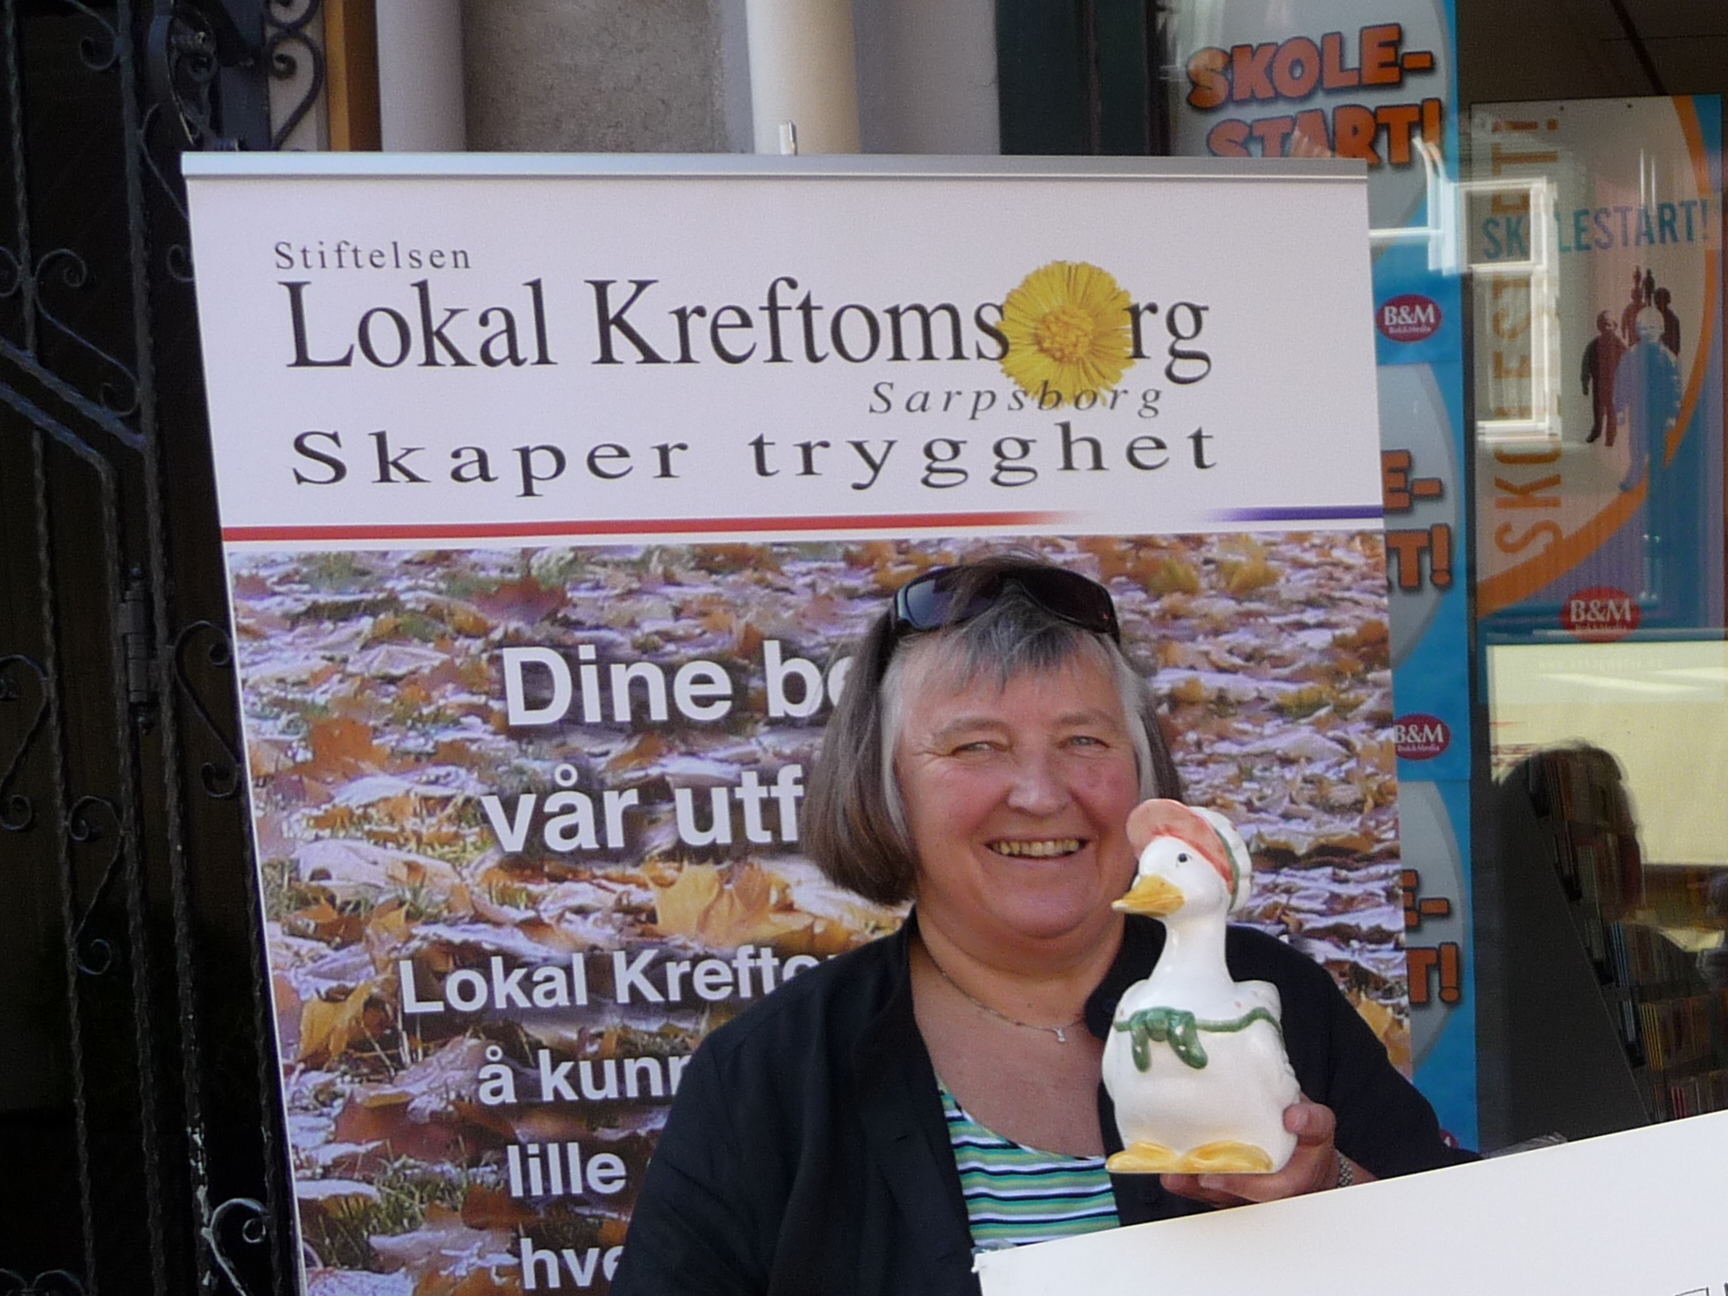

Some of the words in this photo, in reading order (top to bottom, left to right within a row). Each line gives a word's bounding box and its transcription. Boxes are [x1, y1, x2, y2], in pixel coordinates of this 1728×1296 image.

[1186, 22, 1434, 111] SKOLE-
[1205, 97, 1443, 168] START!
[273, 240, 472, 270] Stiftelsen
[1481, 198, 1709, 260] SKLESTART!
[277, 277, 559, 368] Lokal
[583, 275, 1212, 385] Kreftomsrg
[1384, 303, 1436, 326] B&M
[868, 379, 1164, 421] Sarpsborg
[291, 428, 689, 498] Skaper
[747, 420, 1217, 491] trygghet
[1570, 597, 1632, 623] B&M
[500, 644, 733, 728] Dine
[1393, 722, 1445, 744] B&M
[480, 762, 640, 854] vår
[676, 763, 805, 849] utf
[400, 954, 588, 1014] Lokal
[477, 1044, 516, 1106] å
[507, 1141, 628, 1197] lille
